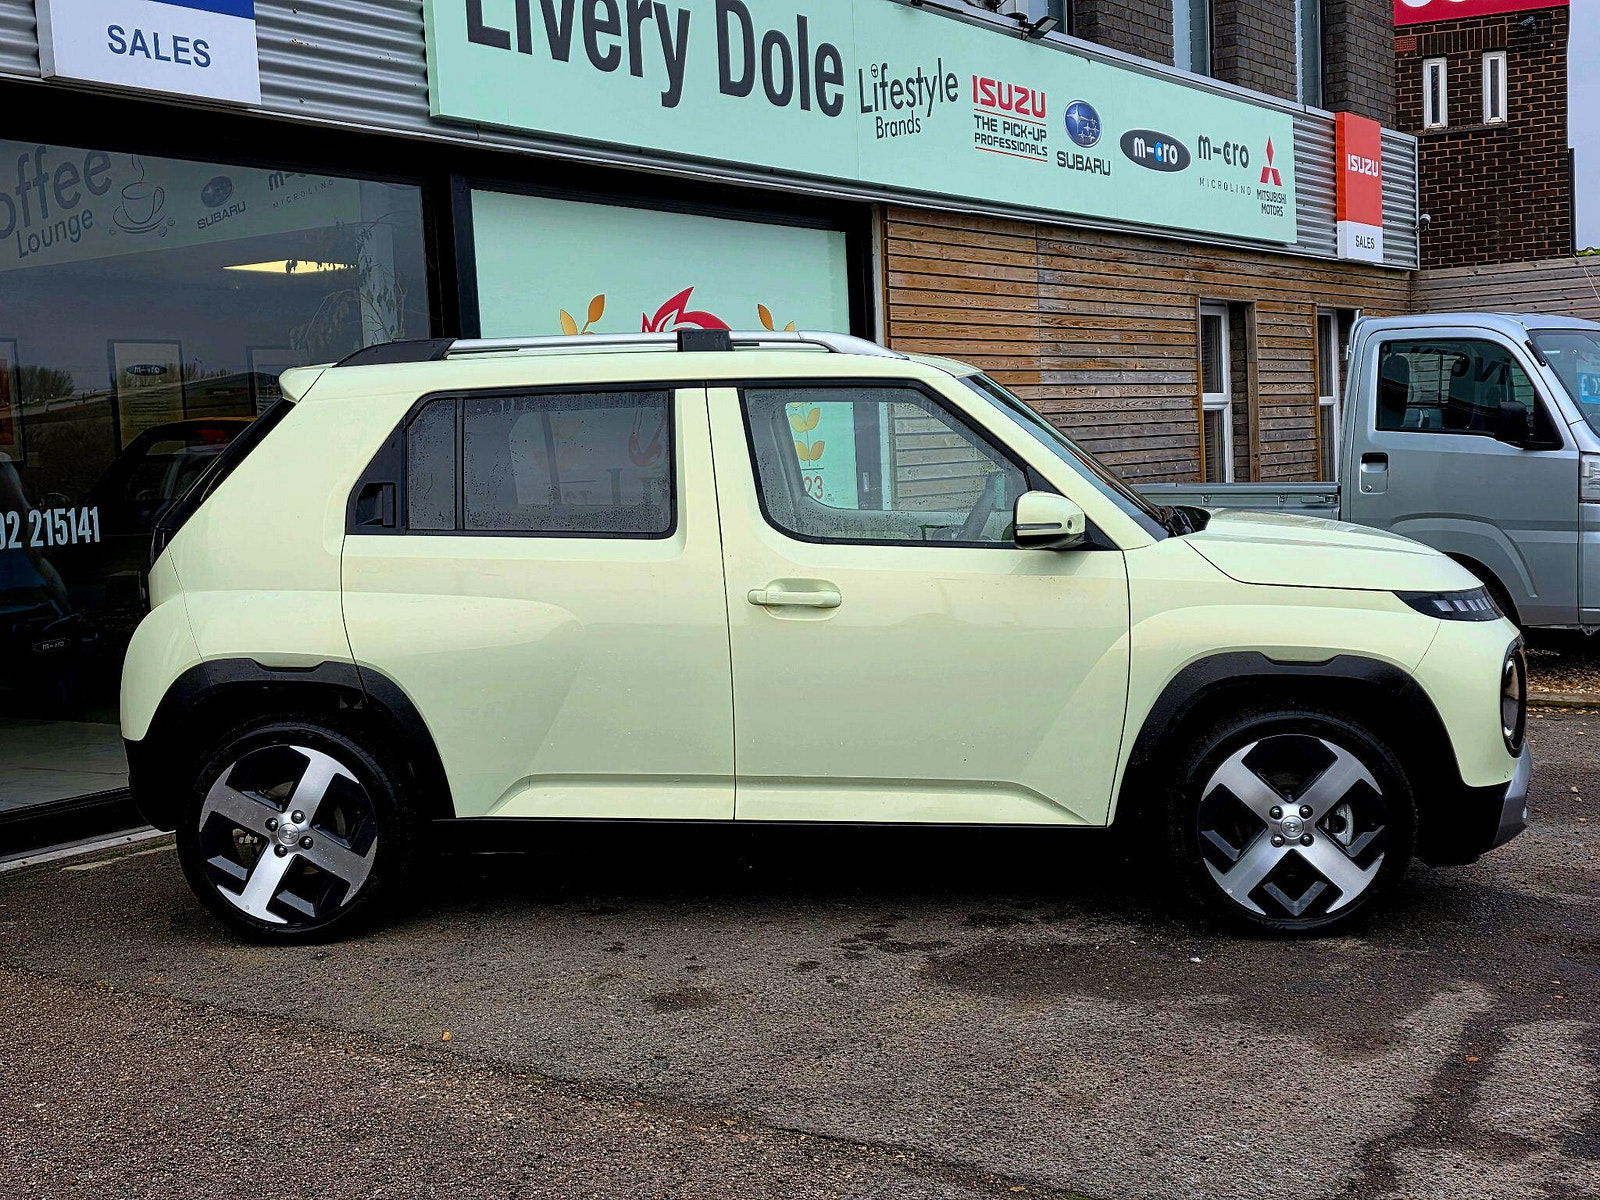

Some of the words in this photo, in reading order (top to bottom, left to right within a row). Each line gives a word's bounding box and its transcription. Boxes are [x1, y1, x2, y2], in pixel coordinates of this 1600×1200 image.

[107, 24, 212, 68] SALES
[715, 0, 845, 117] Dole
[858, 57, 959, 118] Lifestyle
[972, 74, 1047, 119] ISUZU
[876, 109, 922, 139] Brands
[973, 114, 998, 133] THE
[1003, 122, 1047, 141] PICK-UP
[974, 132, 1048, 157] PROFESSIONALS
[1056, 150, 1111, 177] SUBARU
[1347, 154, 1379, 177] ISUZU
[1199, 177, 1252, 196] MICROLINO
[1256, 188, 1287, 205] MITSUBISHI
[197, 201, 247, 230] SUBARU
[1261, 203, 1284, 217] MOTORS
[17, 209, 94, 258] Lounge
[1355, 234, 1375, 250] SALES
[28, 506, 100, 548] 215141
